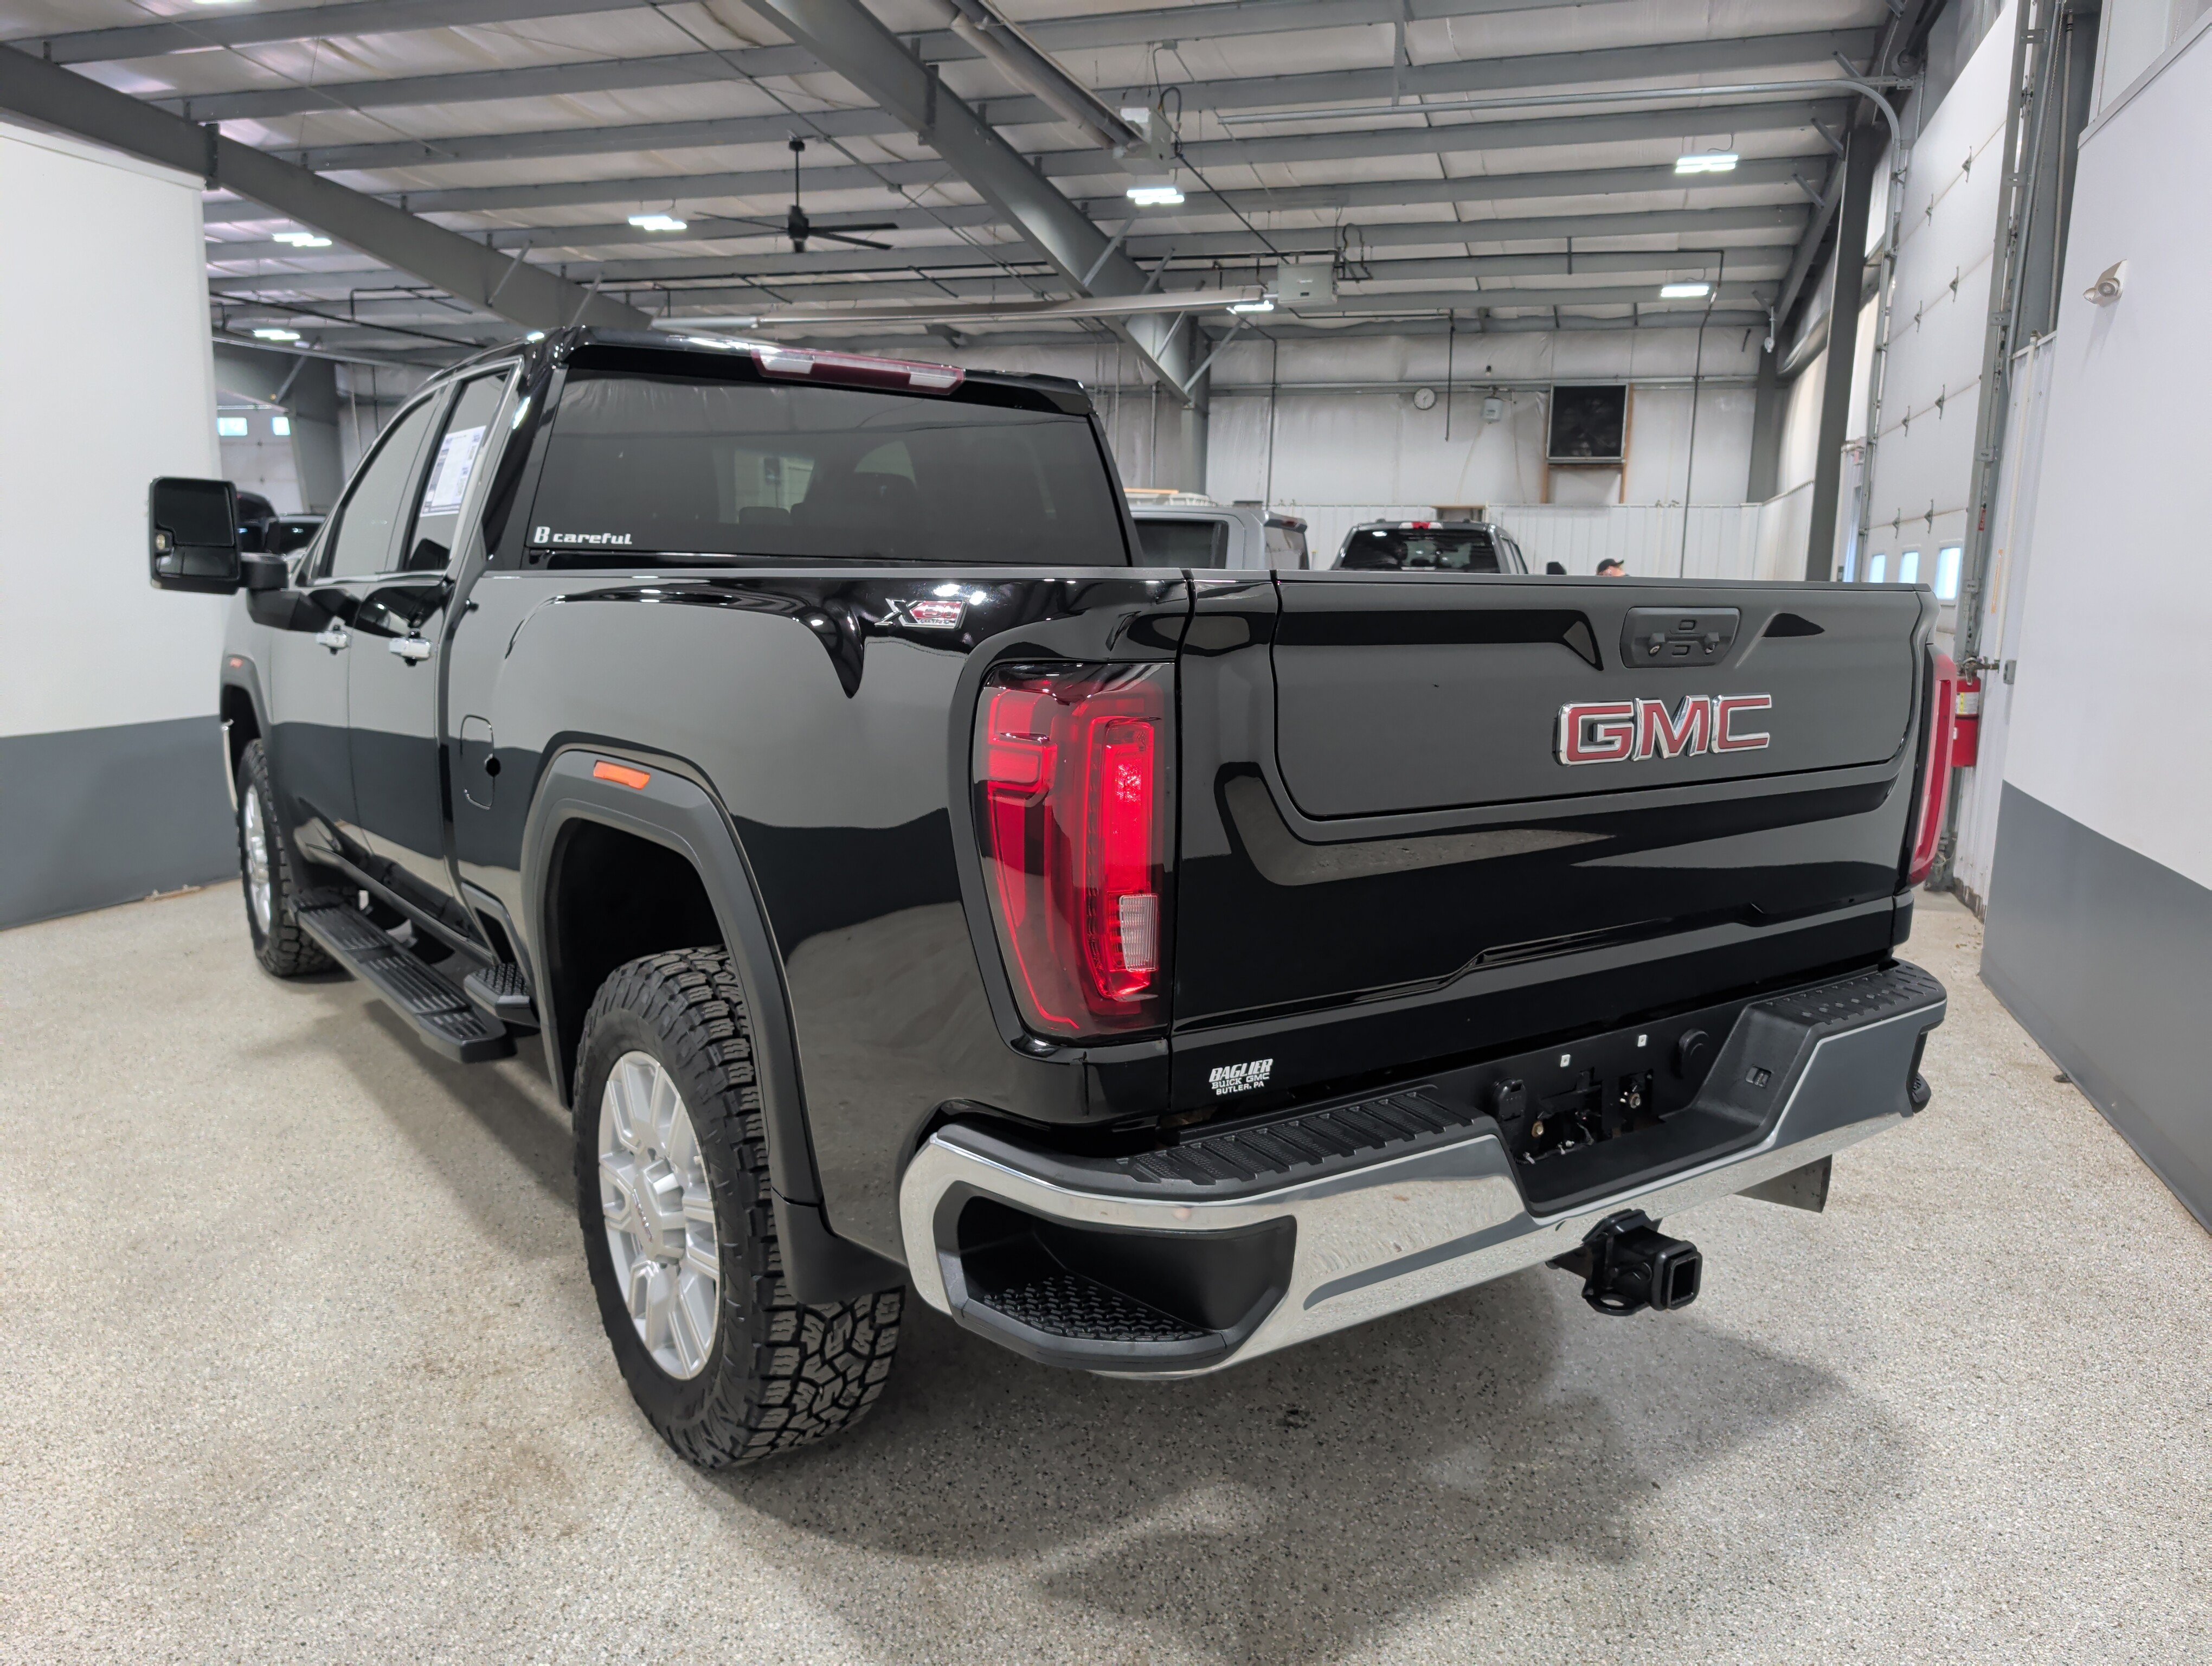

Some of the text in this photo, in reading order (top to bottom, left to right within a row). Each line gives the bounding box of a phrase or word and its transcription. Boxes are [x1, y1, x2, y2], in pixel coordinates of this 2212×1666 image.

[533, 526, 632, 544] B careful
[1552, 693, 1772, 766] GMC
[1209, 1058, 1273, 1082] BAGLIER
[1211, 1073, 1270, 1090] BUICK GMC
